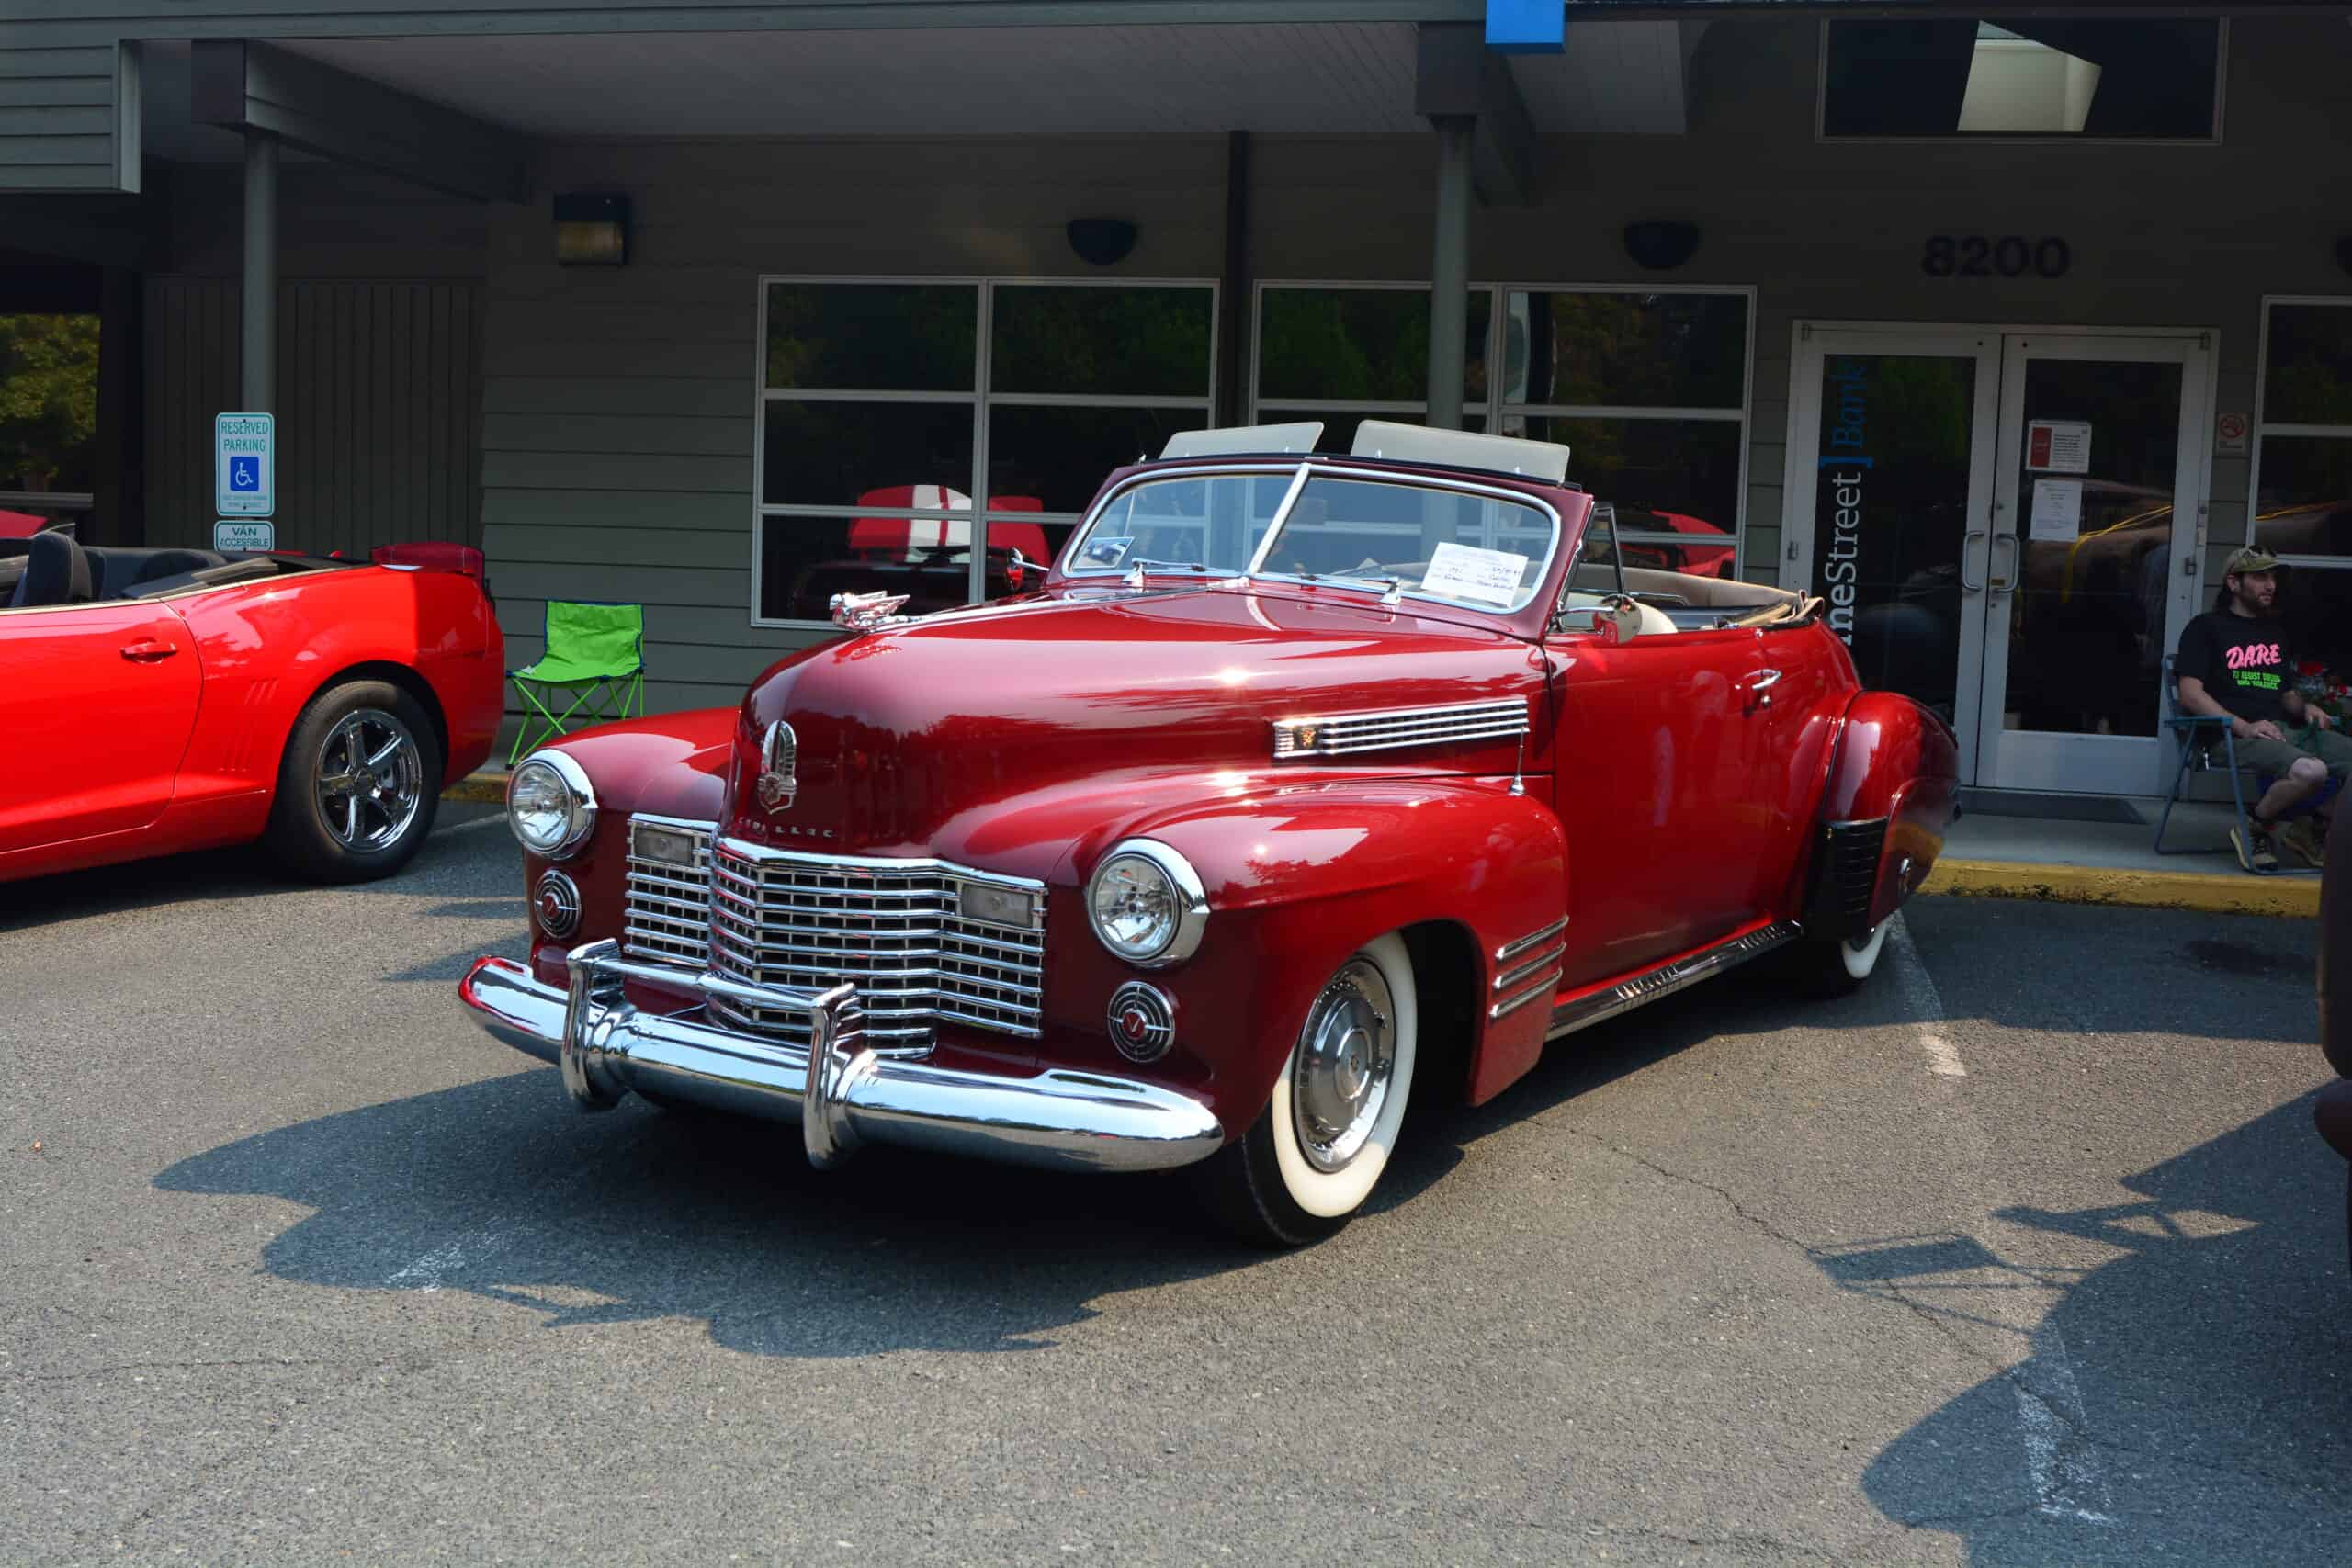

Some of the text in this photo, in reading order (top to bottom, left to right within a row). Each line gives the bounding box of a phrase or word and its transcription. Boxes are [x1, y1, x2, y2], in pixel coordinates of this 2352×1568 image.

[1921, 235, 2071, 279] 8200
[1831, 362, 1868, 448] Bank
[221, 422, 268, 434] RESERVED
[223, 439, 266, 452] PARKING
[232, 527, 257, 536] VAN
[220, 538, 269, 547] ACCESSIBLE
[739, 817, 834, 838] CADILLAC
